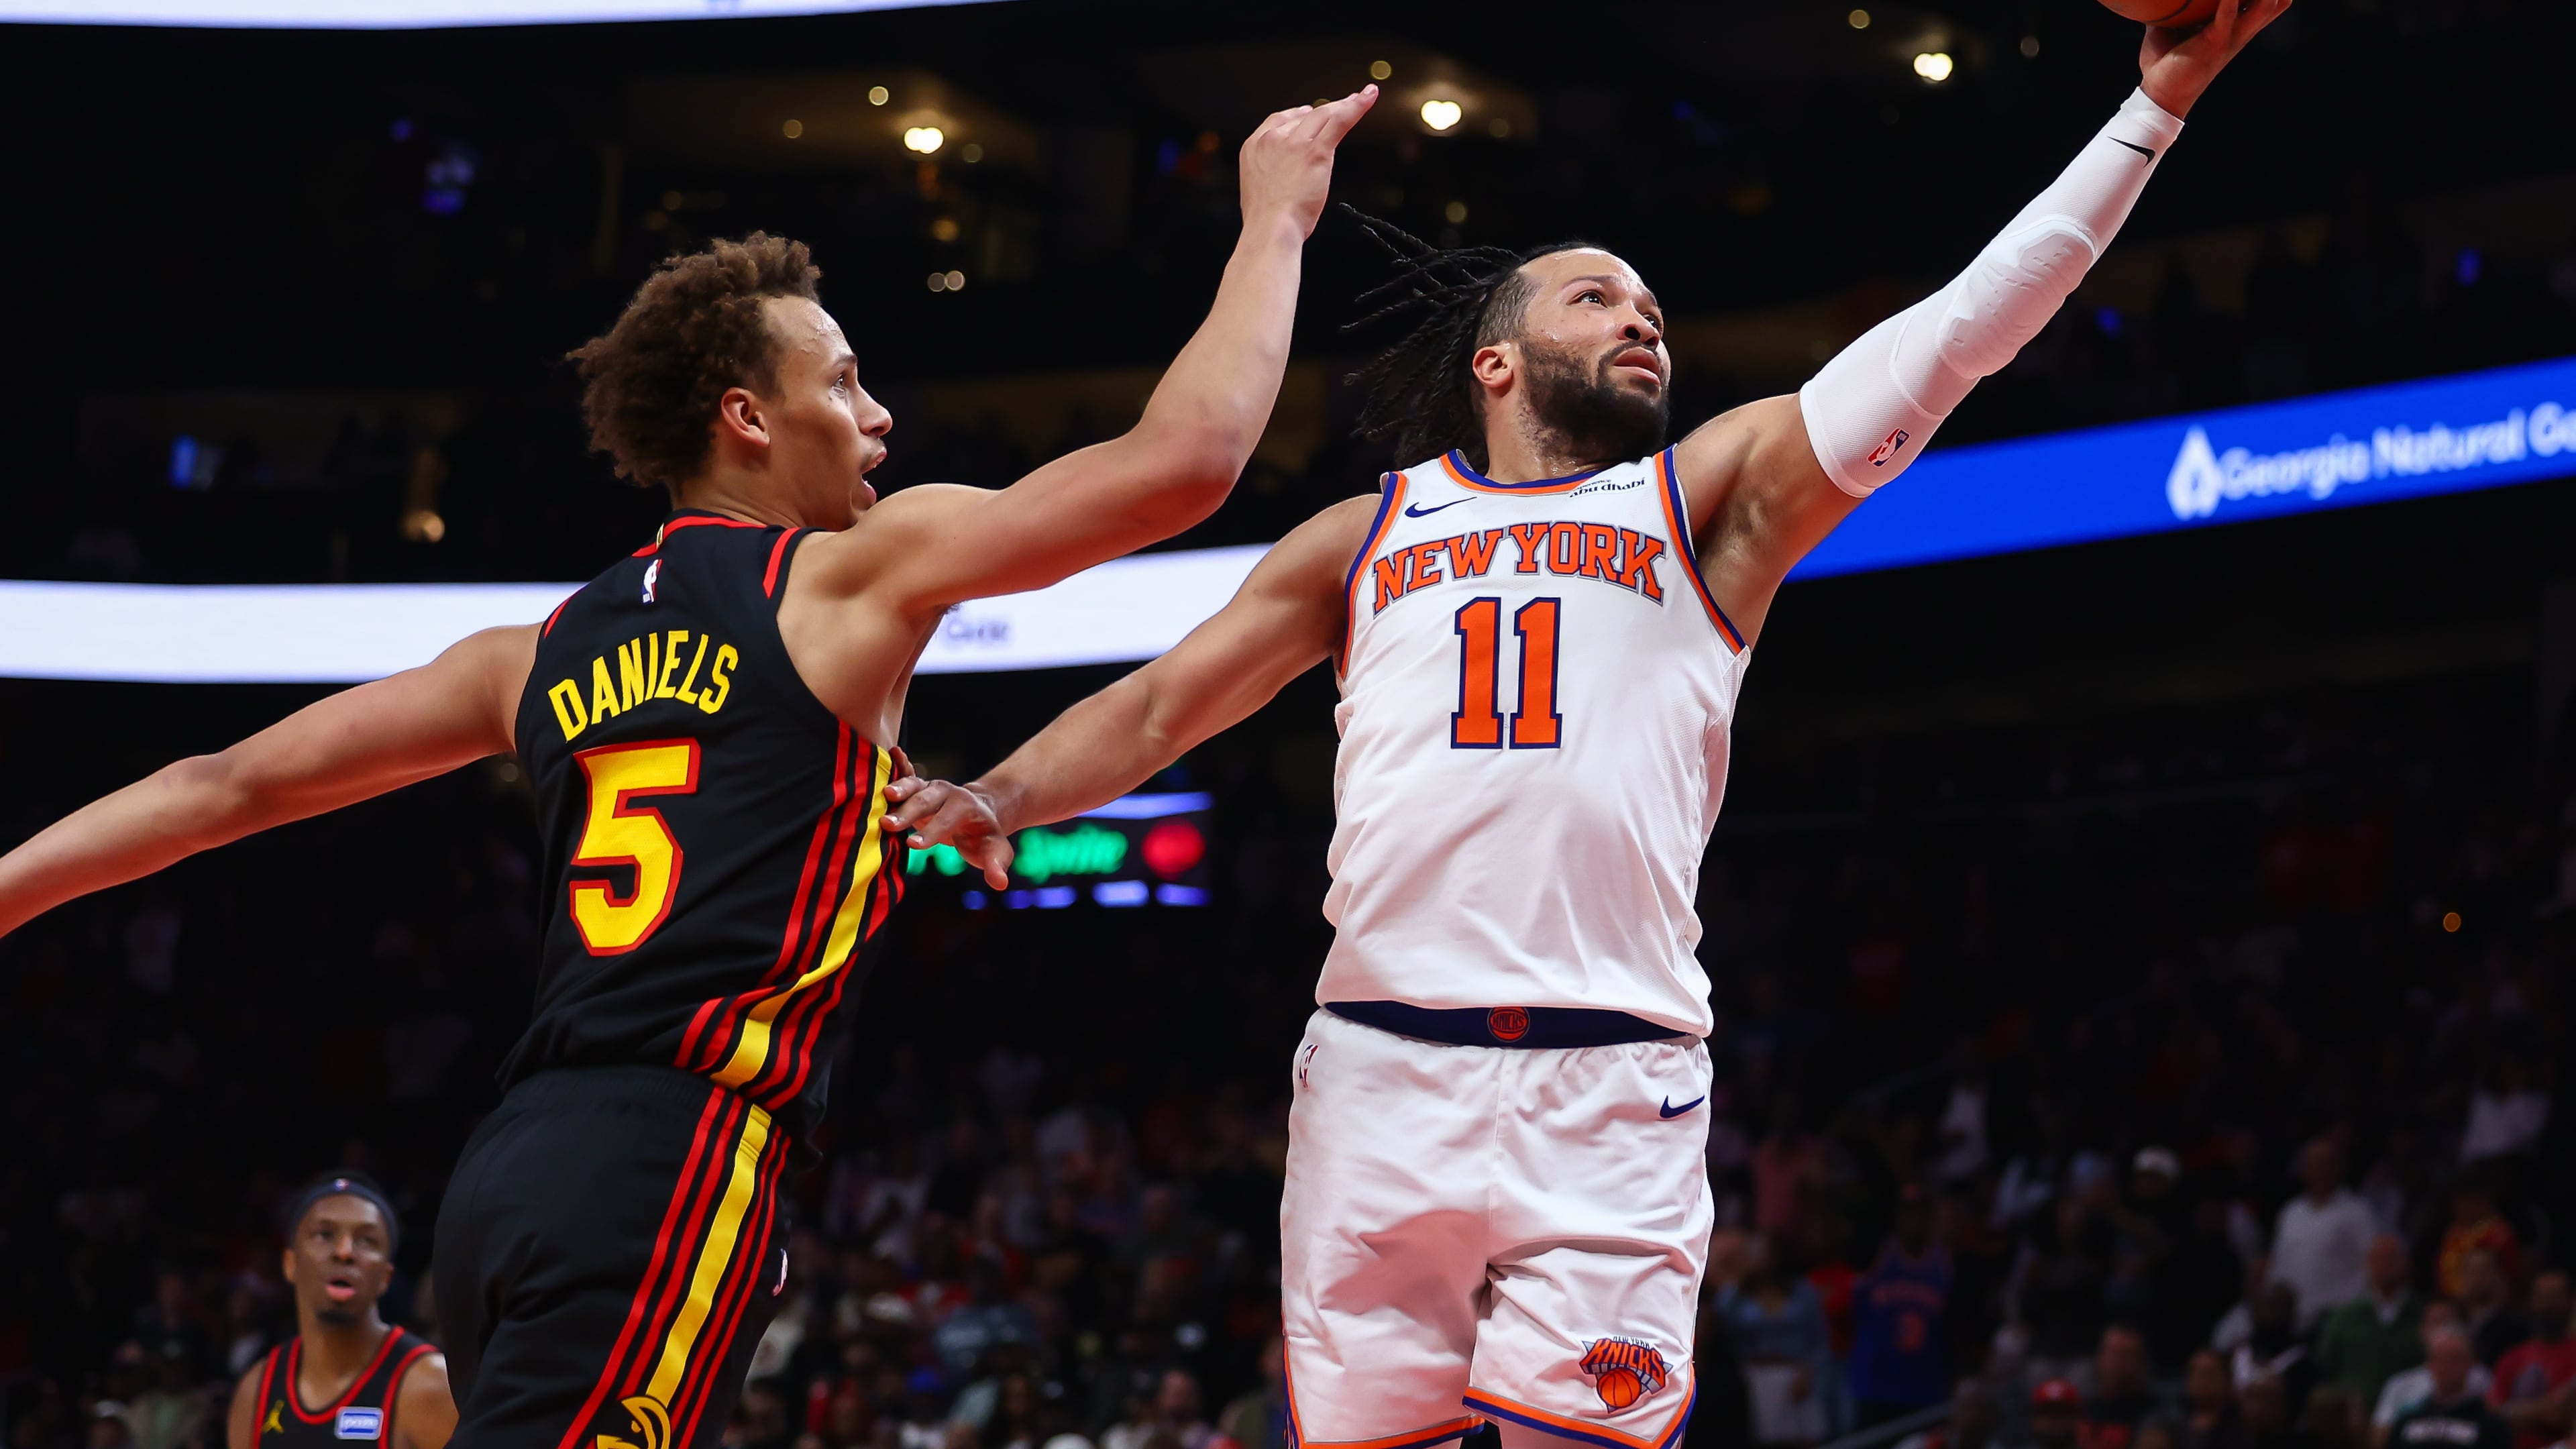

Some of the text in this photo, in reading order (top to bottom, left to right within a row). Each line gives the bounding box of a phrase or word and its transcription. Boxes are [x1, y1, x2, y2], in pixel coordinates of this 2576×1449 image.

[1601, 477, 1646, 491] dhabi
[2220, 432, 2369, 500] Georgia
[2373, 407, 2527, 478] Natural
[1373, 521, 1667, 620] NEW YORK
[547, 630, 739, 743] DANIELS
[1451, 596, 1562, 749] 11
[569, 737, 701, 957] 5
[1579, 1337, 1666, 1389] KNICKS
